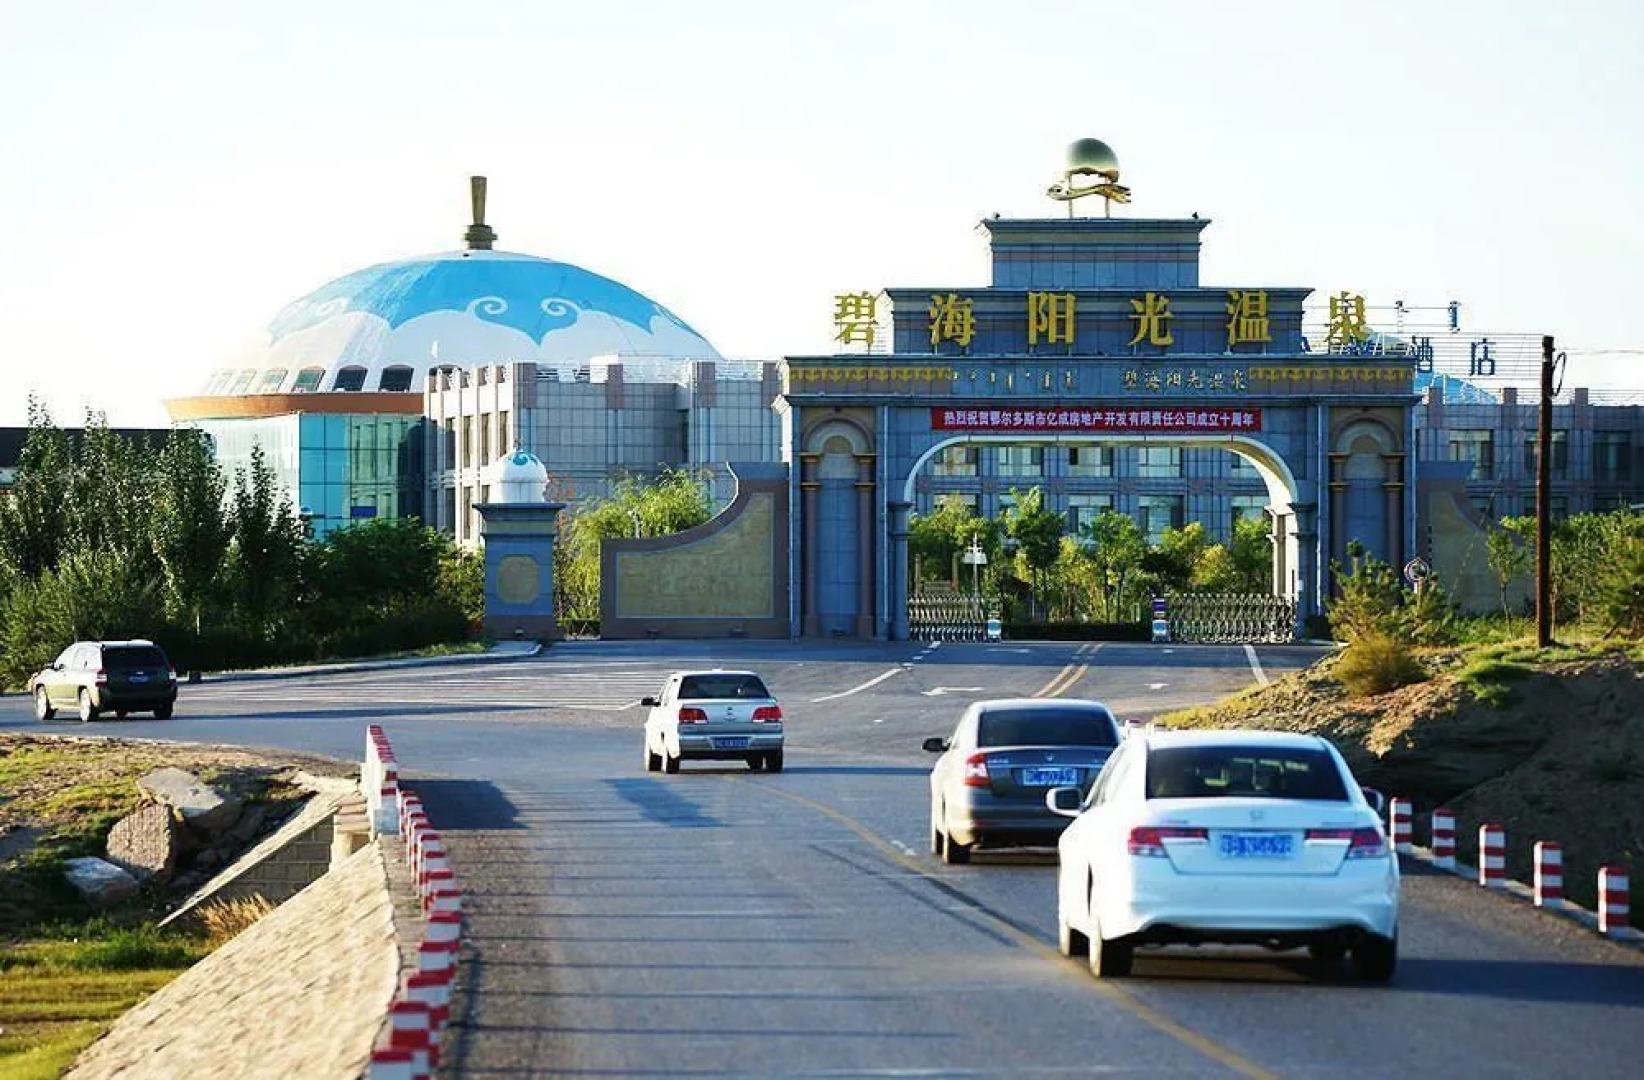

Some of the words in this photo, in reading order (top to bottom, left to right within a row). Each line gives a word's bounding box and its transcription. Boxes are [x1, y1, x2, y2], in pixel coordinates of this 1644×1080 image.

[833, 290, 1370, 347] 碧海阳光温泉
[1123, 369, 1246, 391] 碧海阳光温泉
